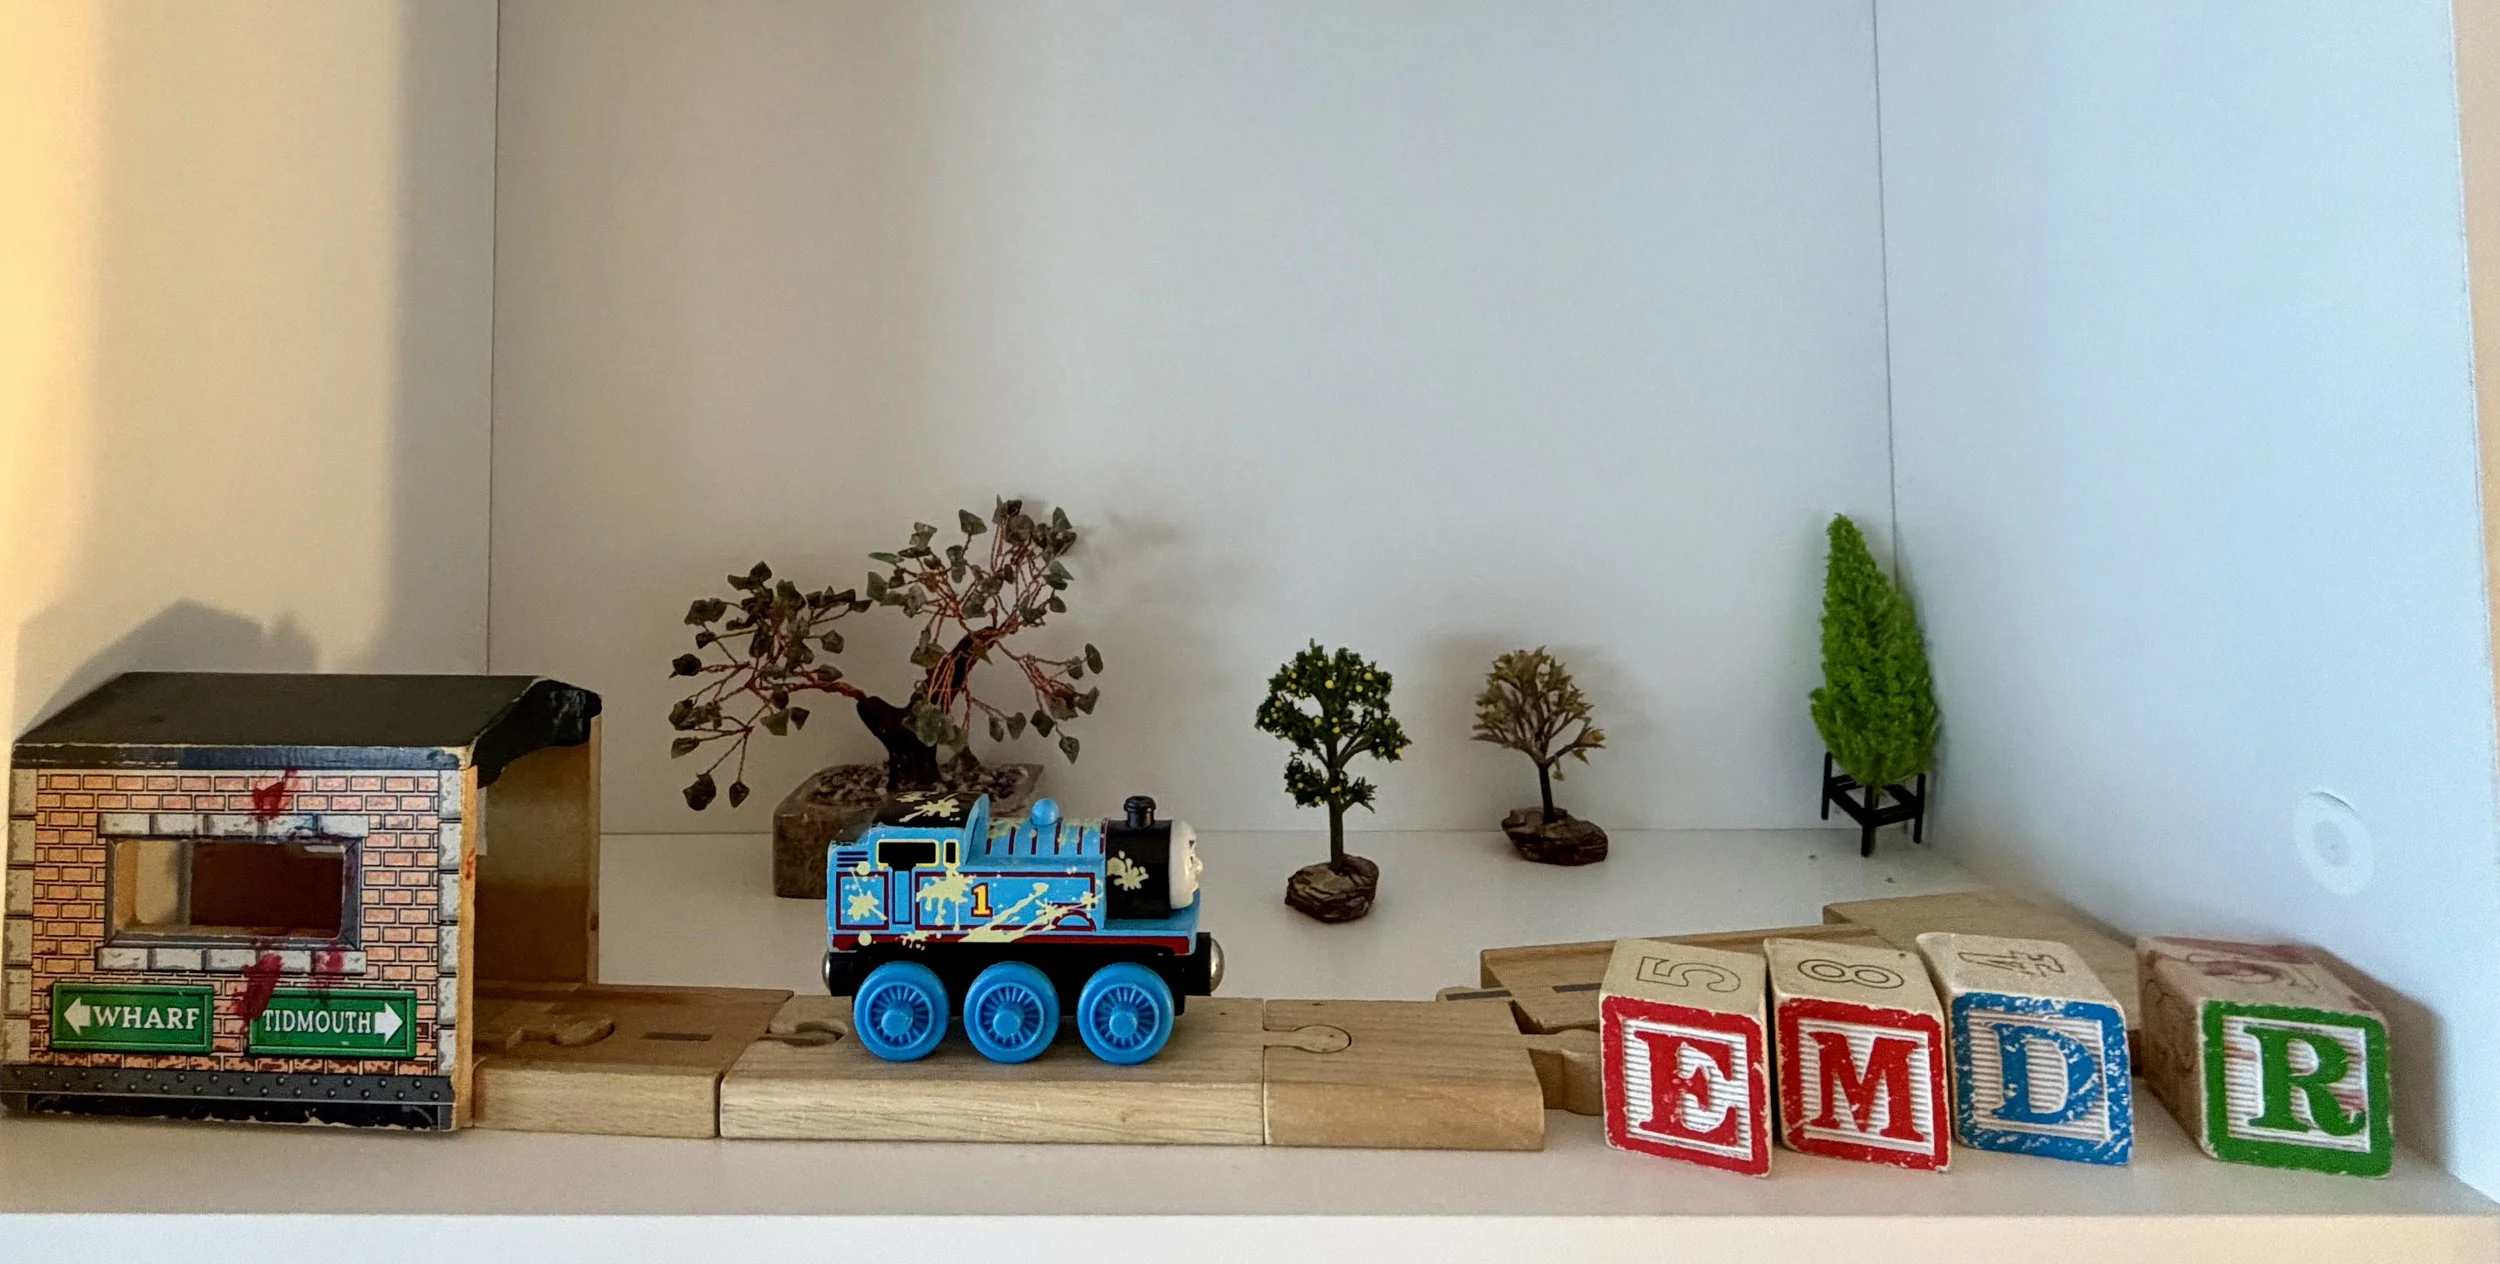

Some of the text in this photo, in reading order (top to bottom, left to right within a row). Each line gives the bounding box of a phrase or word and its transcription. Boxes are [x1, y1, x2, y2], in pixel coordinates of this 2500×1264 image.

[971, 882, 994, 918] 1
[1635, 956, 1741, 993] 5
[1797, 958, 1905, 989] 8
[92, 1005, 201, 1031] WHARF
[262, 1009, 372, 1034] TIDMOUTH
